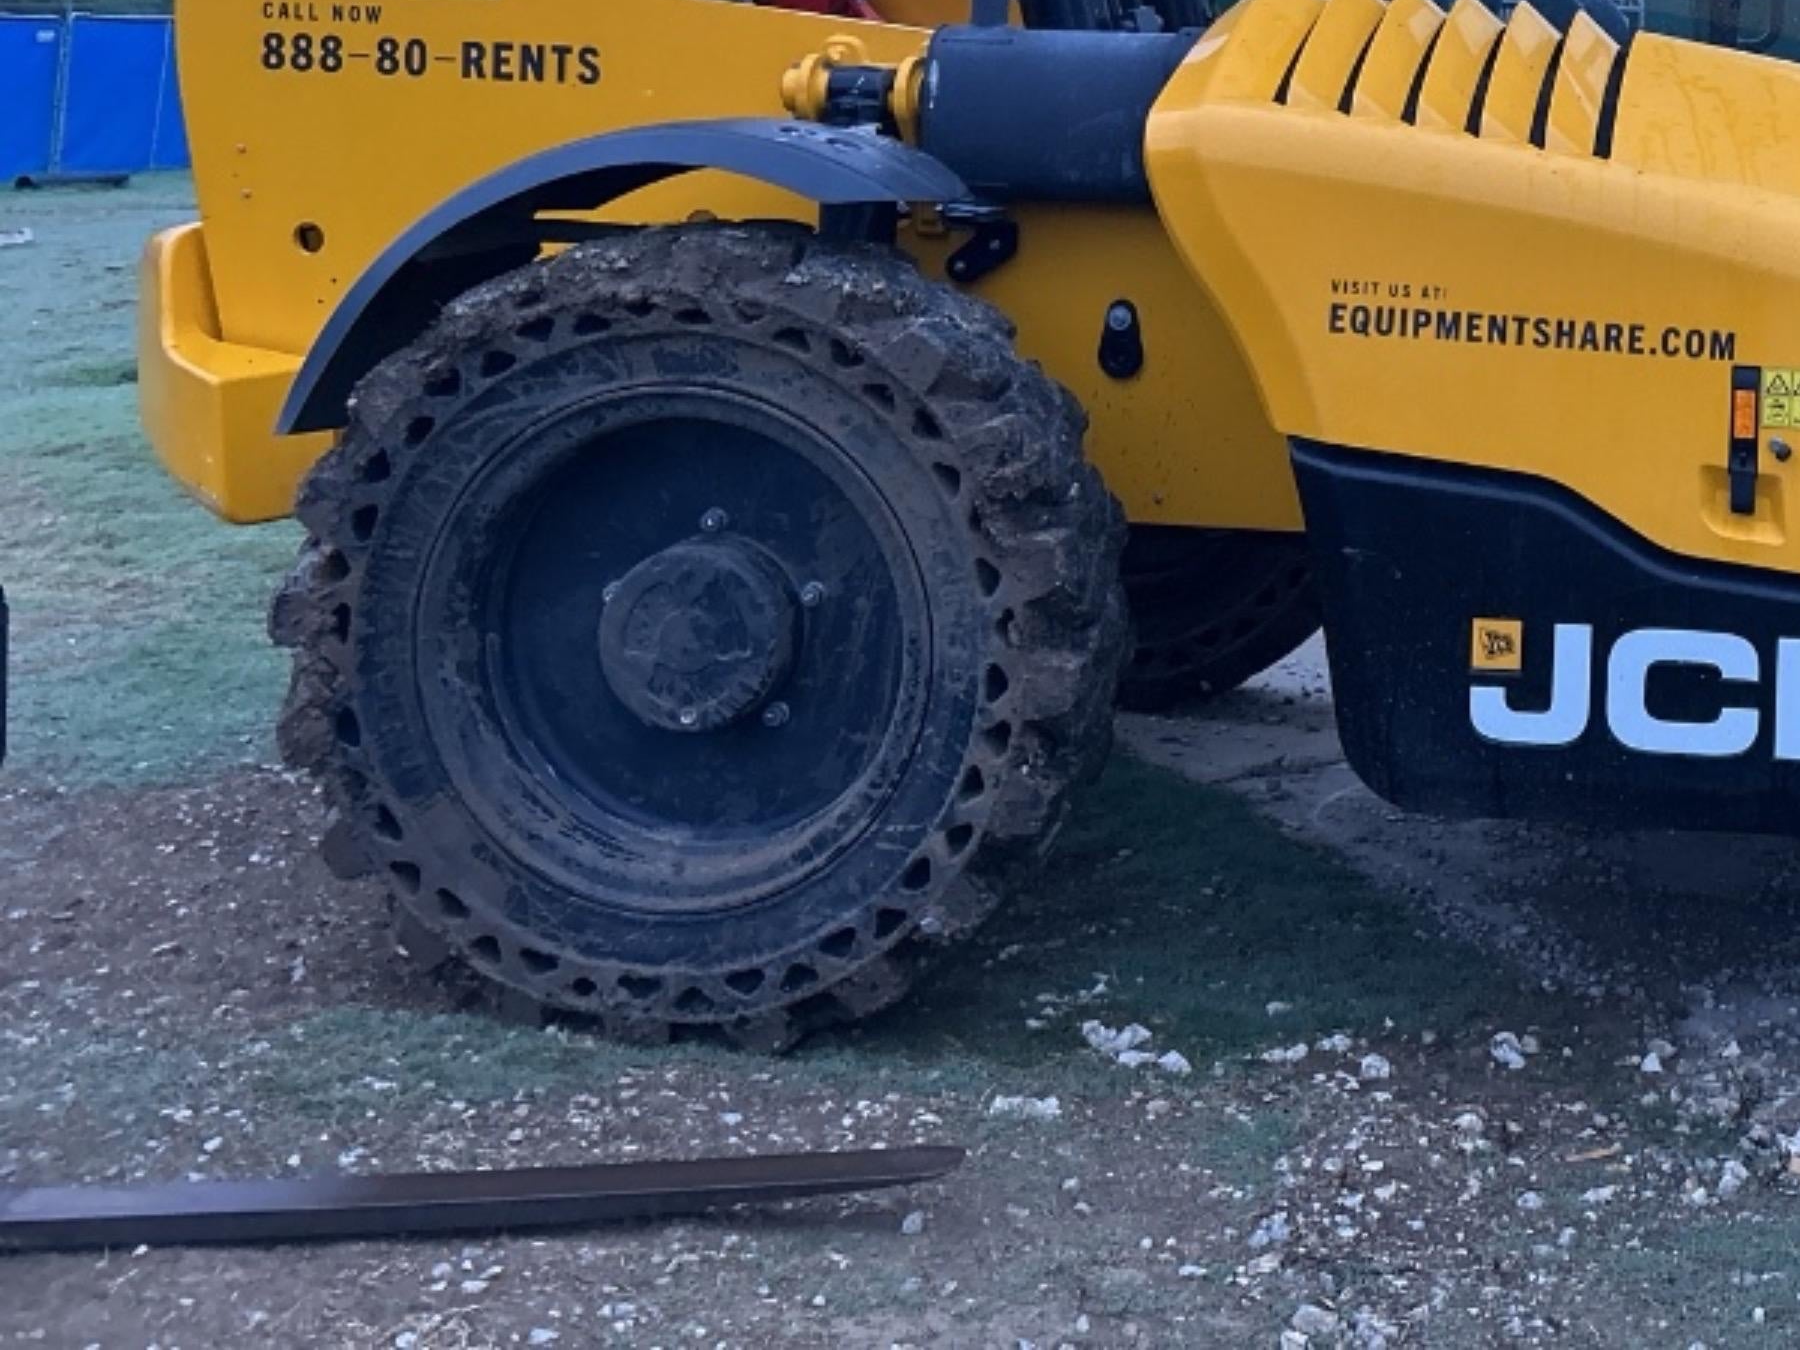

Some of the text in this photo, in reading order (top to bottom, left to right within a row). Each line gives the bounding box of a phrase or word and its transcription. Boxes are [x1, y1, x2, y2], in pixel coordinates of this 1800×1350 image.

[263, 2, 382, 24] CALL NOW
[261, 32, 601, 84] 888-80-RENTS
[1331, 279, 1380, 296] VISIT
[1388, 284, 1411, 298] US
[1329, 302, 1736, 361] EQUIPMENTSHARE.COM
